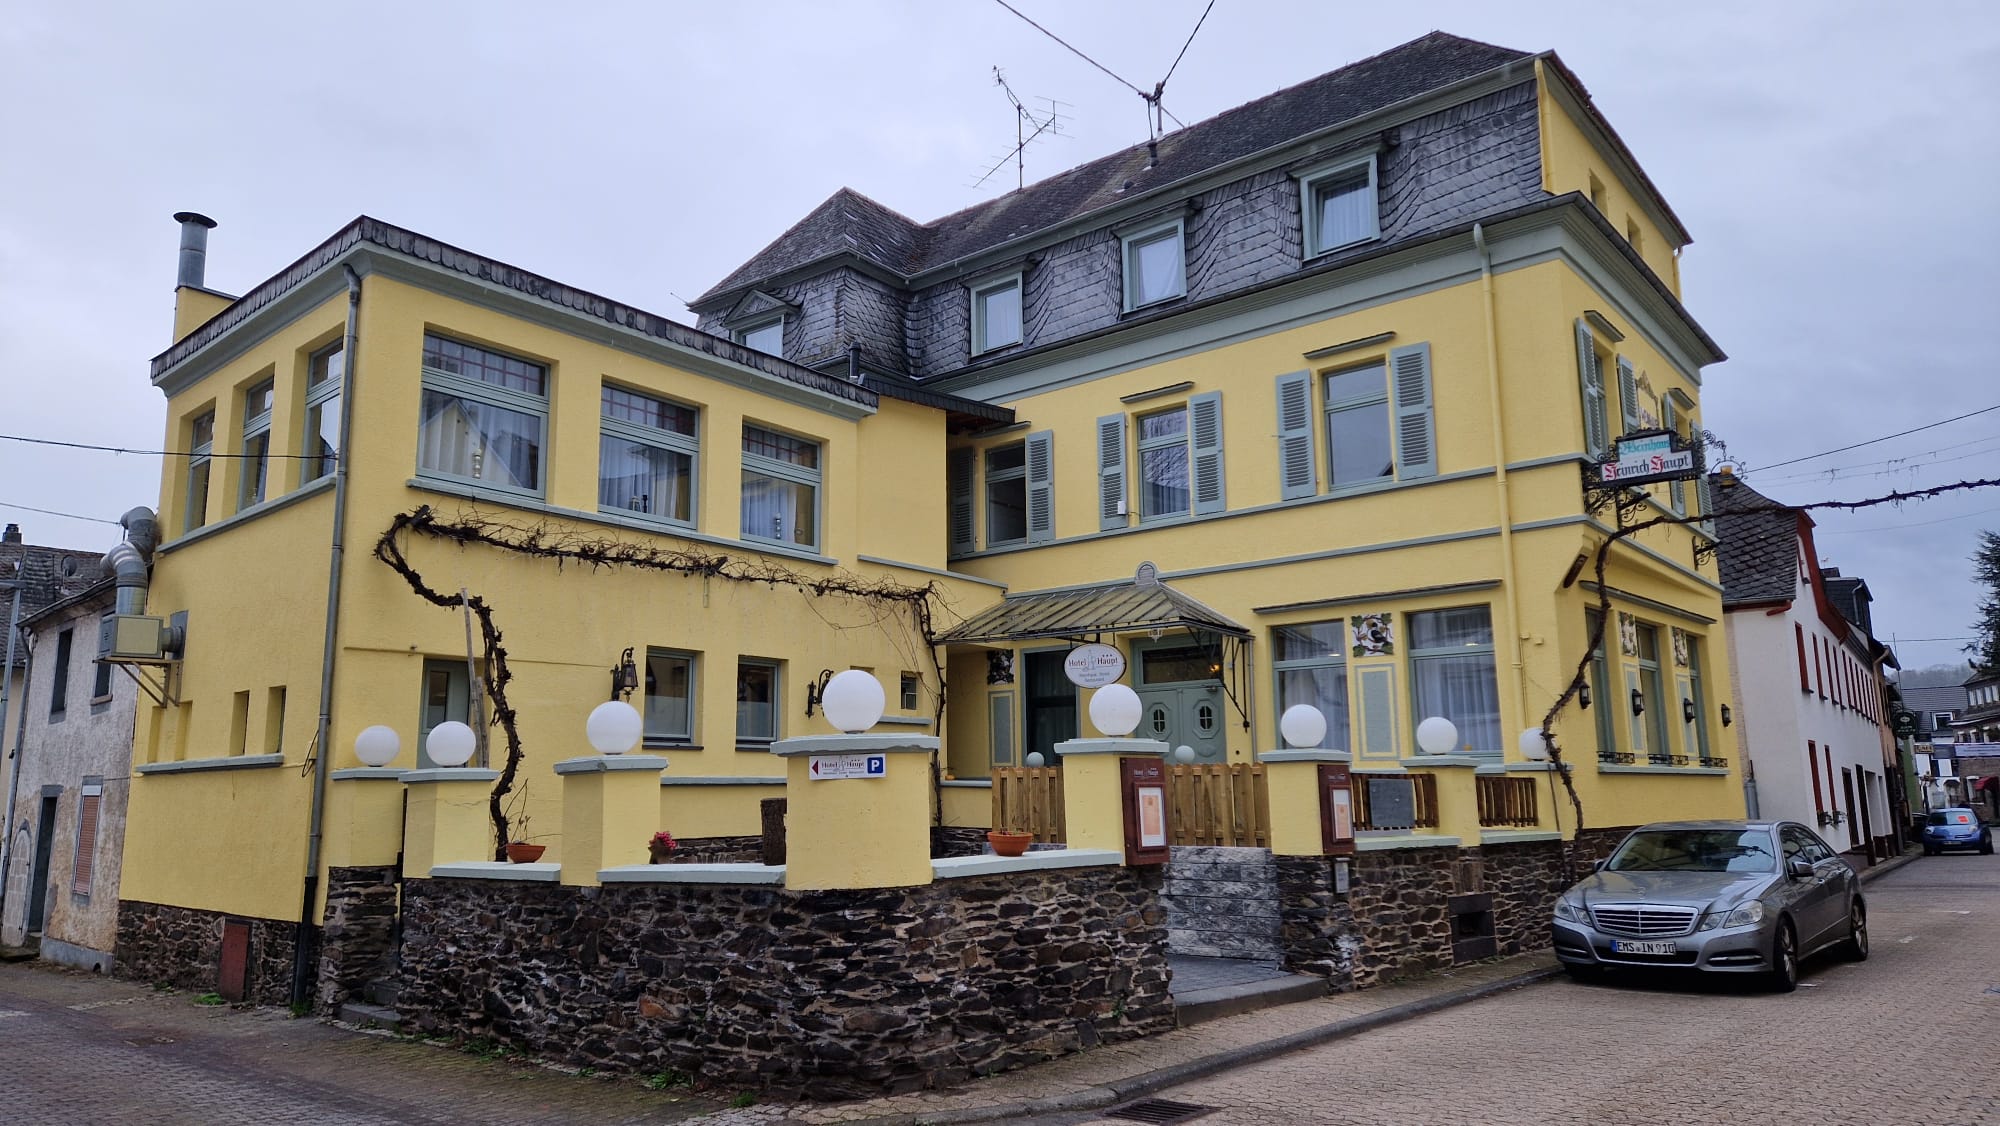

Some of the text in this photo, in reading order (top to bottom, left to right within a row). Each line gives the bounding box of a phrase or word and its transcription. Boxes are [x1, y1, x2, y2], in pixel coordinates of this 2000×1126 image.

[1605, 454, 1688, 480] Heinrich Haupt
[1069, 657, 1118, 666] Hotel Haupt
[871, 759, 880, 771] P
[1617, 942, 1635, 952] EMS
[1642, 943, 1654, 953] IN
